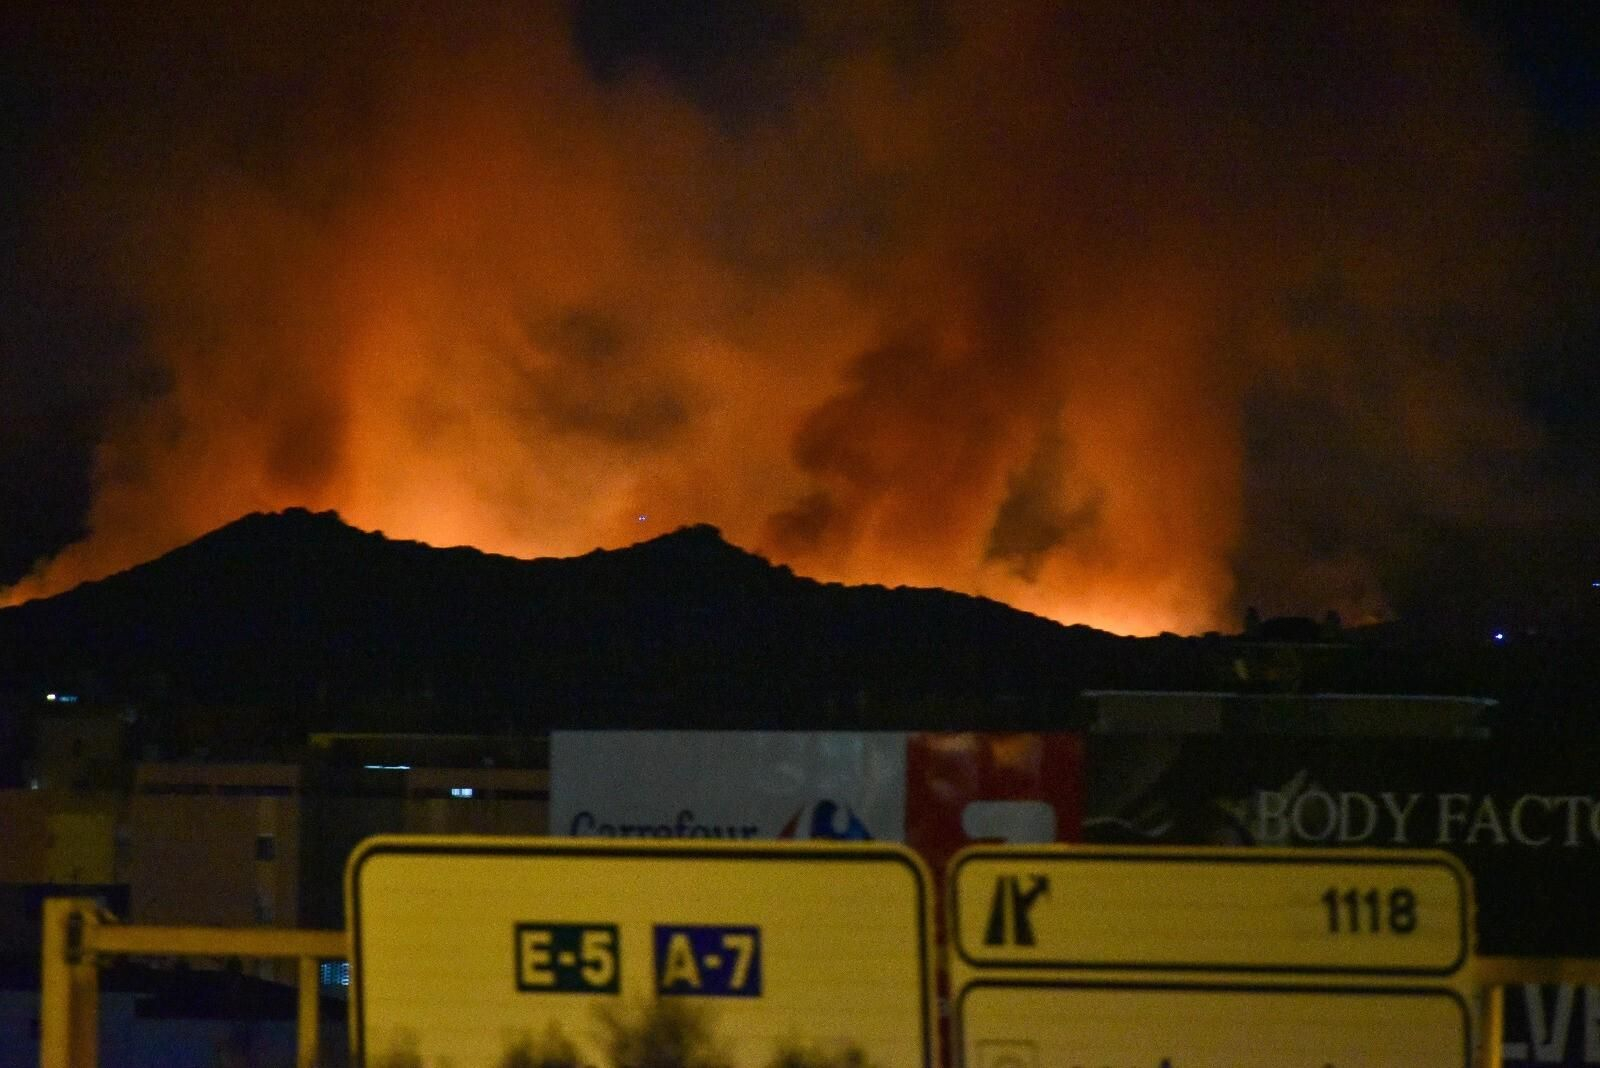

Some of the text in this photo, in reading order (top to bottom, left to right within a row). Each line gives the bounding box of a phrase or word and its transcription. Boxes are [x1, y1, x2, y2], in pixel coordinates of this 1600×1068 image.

[1256, 787, 1421, 844] BODY
[1322, 888, 1417, 934] 1118
[520, 928, 756, 990] E-5 A-7
